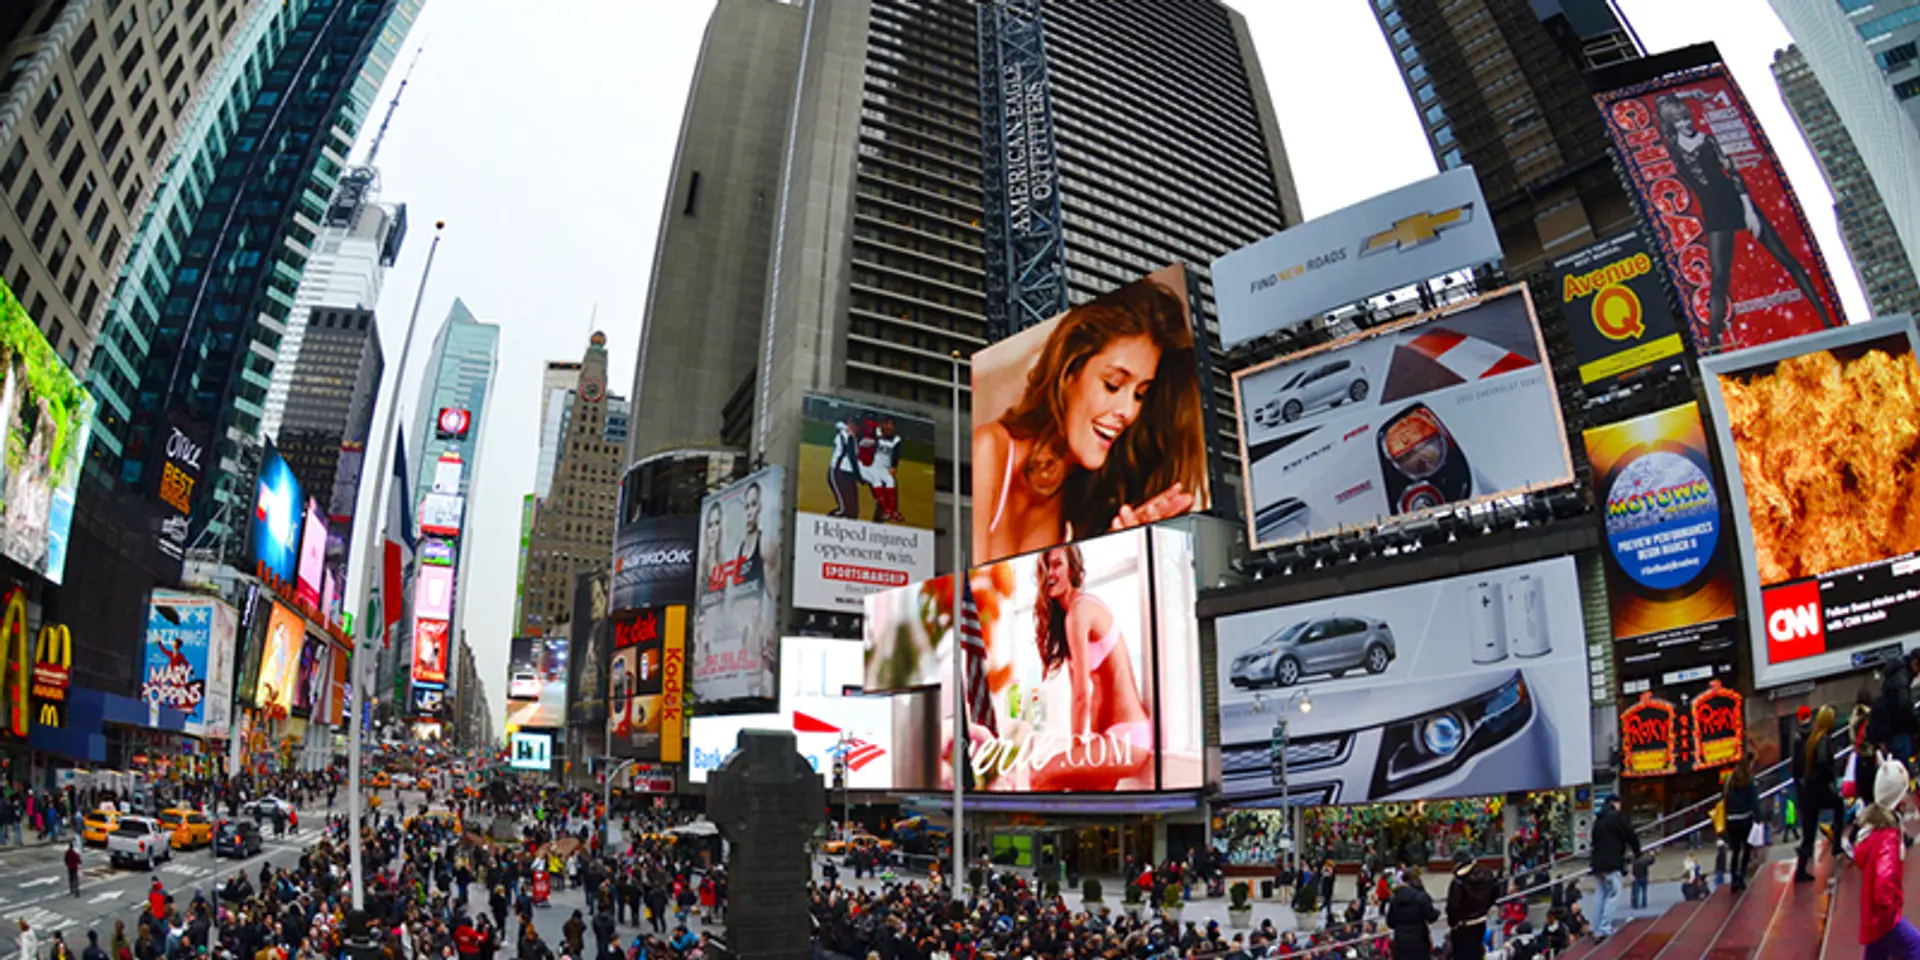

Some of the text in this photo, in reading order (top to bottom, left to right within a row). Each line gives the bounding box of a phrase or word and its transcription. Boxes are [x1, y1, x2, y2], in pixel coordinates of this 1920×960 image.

[1004, 62, 1031, 236] AMERICAN EAGLE
[1025, 81, 1052, 200] OUTFITTERS
[1612, 99, 1733, 325] CHICAGO
[1250, 247, 1348, 294] FIND NEW ROADS
[1563, 252, 1651, 302] Avenue
[1591, 284, 1646, 340] Q
[1608, 479, 1709, 519] MOTOWN
[814, 520, 918, 548] Helped injured
[814, 543, 917, 565] opponent win.
[1618, 521, 1713, 553] PREVIEW PERFORMANCES
[1637, 546, 1660, 560] BEGIN
[1662, 540, 1689, 555] MARCH
[709, 555, 747, 592] UFC
[825, 565, 906, 585] SPORTSMANSHIP
[615, 610, 657, 650] Kodak
[1769, 602, 1820, 642] CNN
[142, 681, 203, 709] POPPINS
[149, 664, 193, 688] MARY
[664, 648, 682, 720] Kodak
[694, 746, 725, 769] Bank
